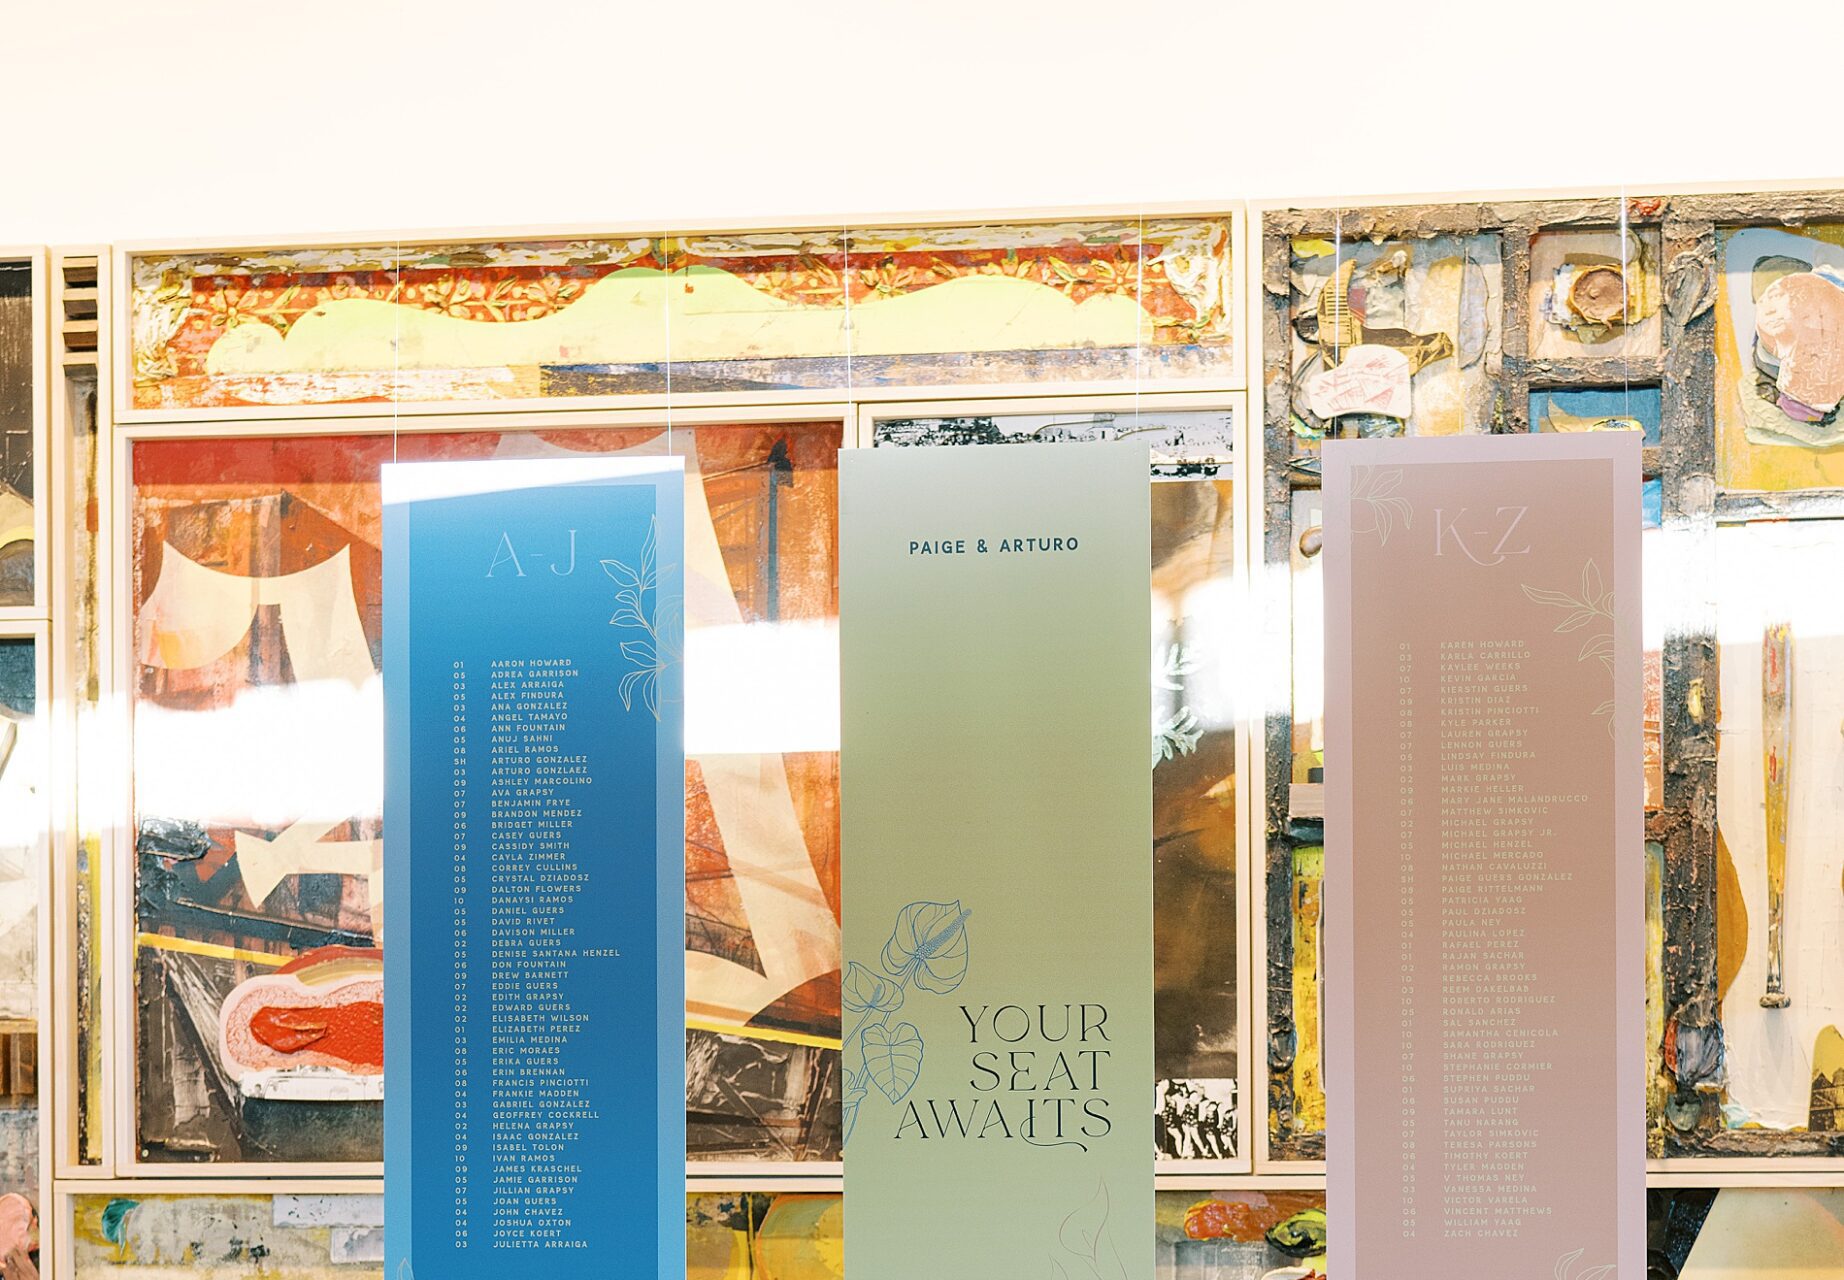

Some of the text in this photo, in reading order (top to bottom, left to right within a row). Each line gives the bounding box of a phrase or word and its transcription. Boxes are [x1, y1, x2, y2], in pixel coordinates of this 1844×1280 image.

[908, 537, 1080, 555] PAIGE & ARTURO
[453, 658, 572, 669] 01 AARON HOWARD
[453, 680, 564, 690] 03 ALEX ARRAIGA
[453, 702, 567, 712] 03 ANA GONZALEZ
[453, 712, 568, 723] 04 ANGEL TAMAYO
[453, 734, 552, 744] 05 ANUJ SAHNI
[454, 755, 587, 766] SH ARTURO GONZALEZ
[454, 777, 592, 787] 09 ASHLEY MARCOLINO
[454, 788, 554, 798] 07 AVA GRAPSY
[454, 809, 582, 819] 09 BRANDON MENDEZ
[454, 831, 561, 840] 07 CASEY GUERS
[454, 852, 565, 862] 04 CAYLA ZIMMER
[454, 873, 589, 883] 05 CRYSTAL DZIADOSZ
[454, 885, 581, 894] 09 DALTON FLOWERS
[454, 895, 573, 905] 10 DANAYSI RAMOS
[454, 917, 555, 926] 05 DAVID RIVET
[454, 938, 561, 948] 02 DEBRA GUERS
[454, 971, 568, 980] 09 DREW BARNETT
[454, 992, 564, 1002] 02 EDITH GRAPSY
[454, 1014, 589, 1023] 02 ELISABETH WILSON
[958, 1003, 1112, 1043] YOUR
[454, 1025, 580, 1034] 01 ELIZABETH PEREZ
[455, 1035, 567, 1044] 03 EMILIA MEDINA
[455, 1057, 559, 1066] 05 ERIKA GUERS
[970, 1050, 1112, 1092] SEAT
[455, 1089, 579, 1098] 04 FRANKIE MADDEN
[455, 1122, 574, 1130] 02 HELENA GRAPSY
[893, 1098, 1112, 1153] AWAITS
[455, 1143, 564, 1152] 09 ISABEL TOLON
[455, 1154, 555, 1162] 10 IVAN RAMOS
[455, 1165, 582, 1173] 09 JAMES KRASCHEL
[455, 1208, 563, 1216] 04 JOHN CHAVEZ
[455, 1219, 571, 1227] 04 JOSHUA OXTON
[455, 1240, 588, 1248] 03 JULIETTA ARRAIGA
